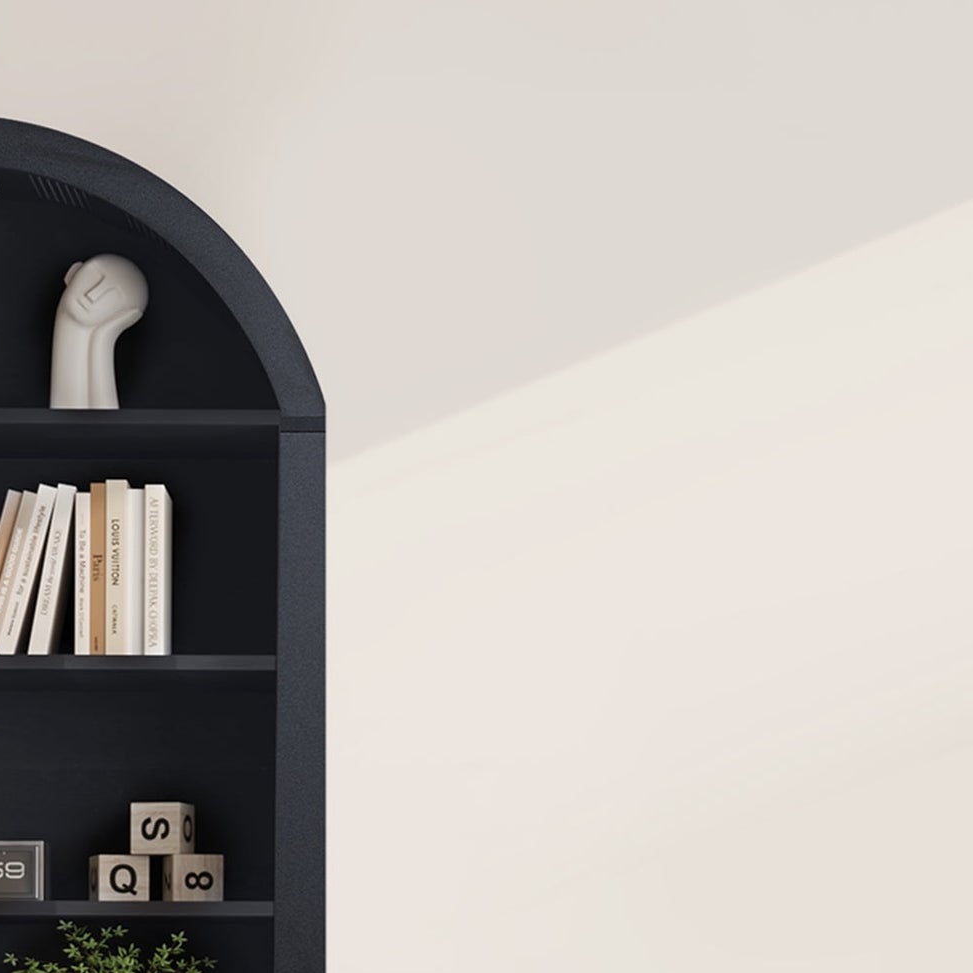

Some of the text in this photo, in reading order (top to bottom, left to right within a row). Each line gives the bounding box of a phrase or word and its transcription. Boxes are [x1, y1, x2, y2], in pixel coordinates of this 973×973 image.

[34, 505, 46, 535] lifestyle
[5, 553, 17, 578] GOOD
[110, 519, 120, 586] LOUIS VUITTON
[92, 554, 102, 581] Paris
[147, 496, 159, 648] AFTERWORD BY DEEPAK CHOPRA
[141, 817, 170, 841] S
[109, 864, 137, 896] Q
[185, 871, 214, 891] 8
